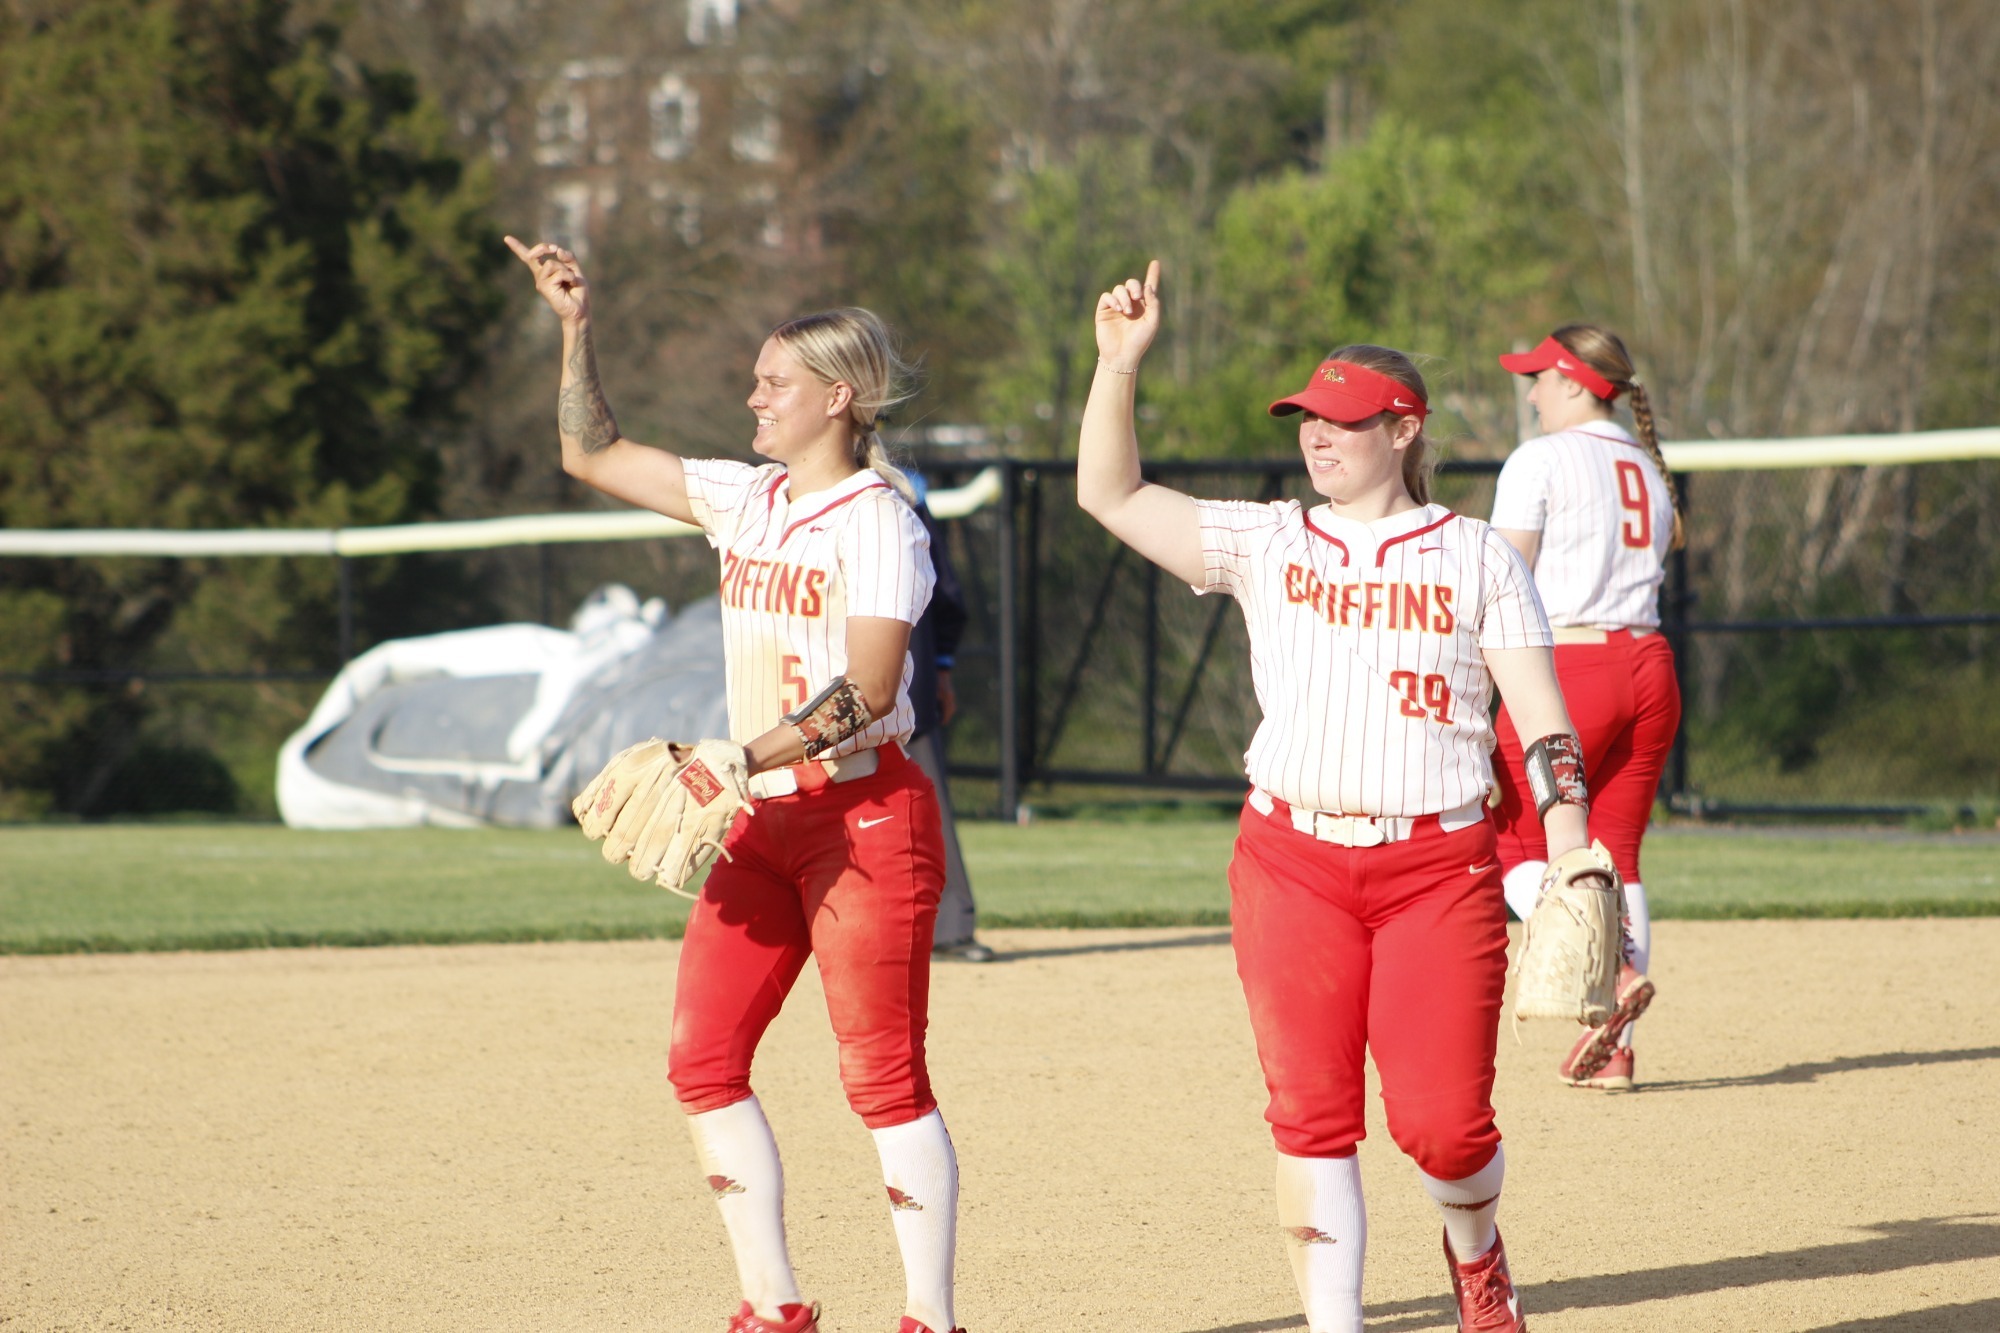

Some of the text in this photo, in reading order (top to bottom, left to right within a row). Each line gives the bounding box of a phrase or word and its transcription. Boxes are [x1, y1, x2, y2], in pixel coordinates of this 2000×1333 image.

[1614, 459, 1652, 549] 9
[1284, 562, 1455, 635] GRIFFINS
[781, 654, 808, 720] 5
